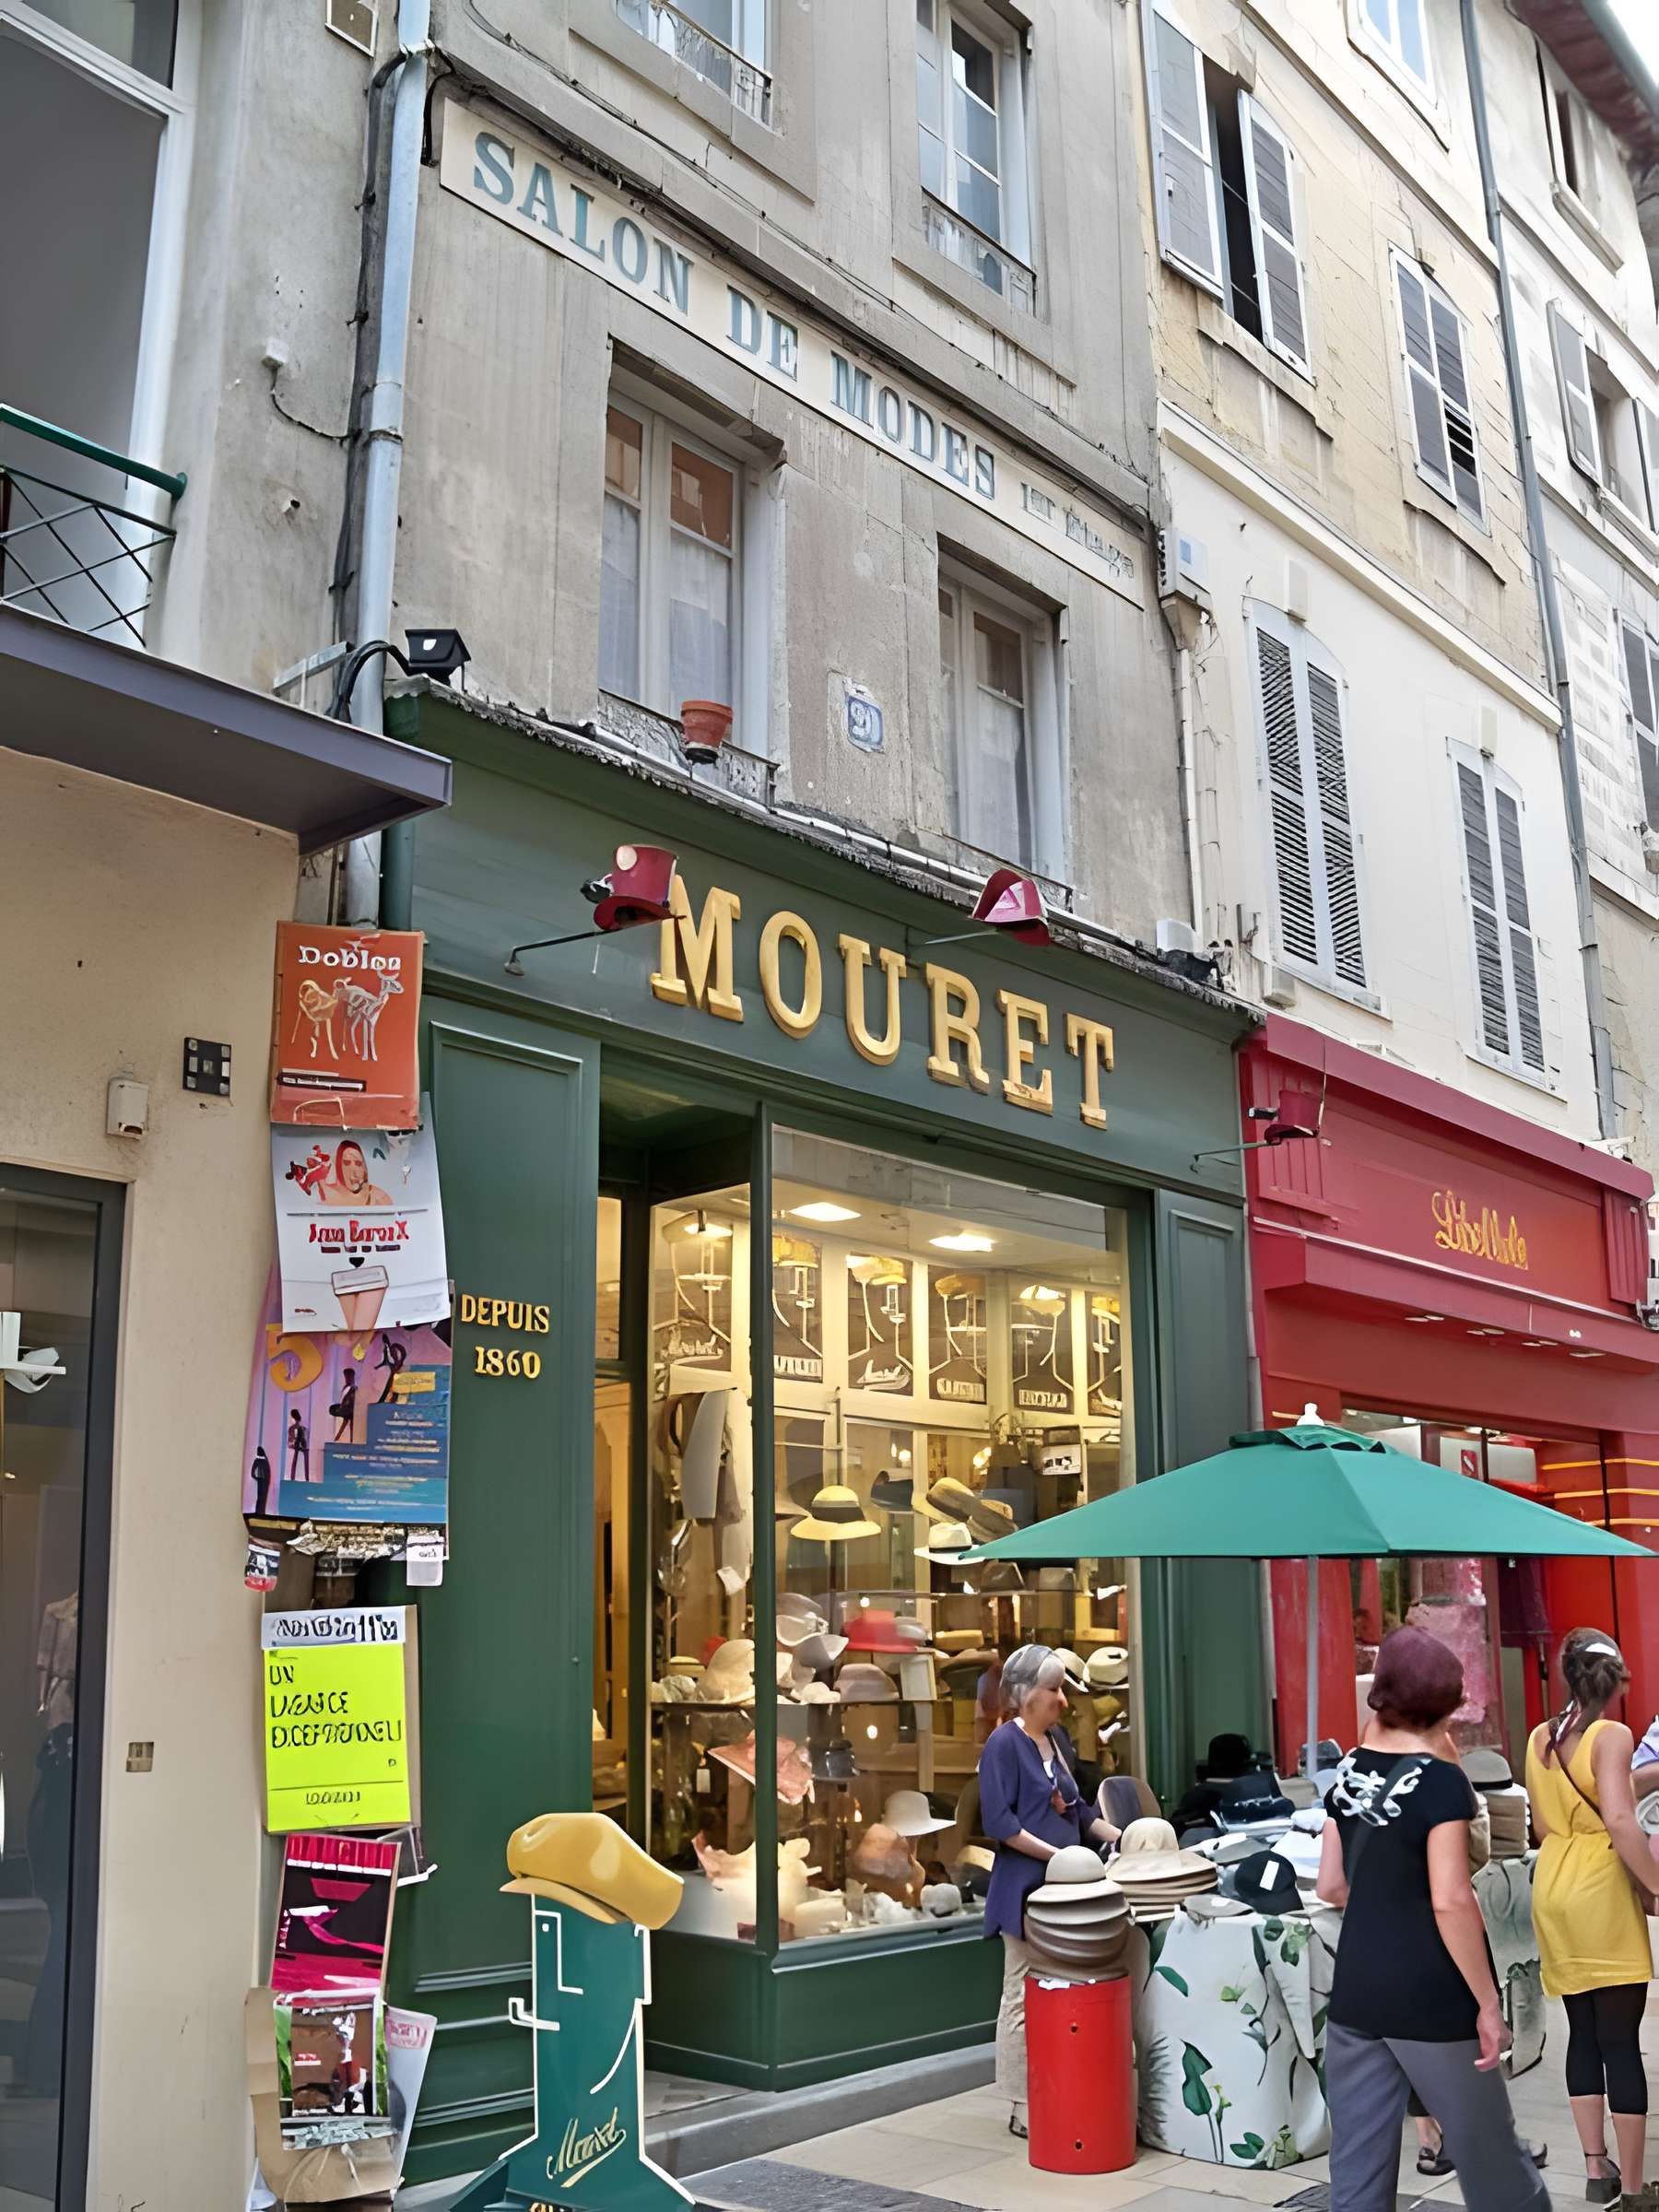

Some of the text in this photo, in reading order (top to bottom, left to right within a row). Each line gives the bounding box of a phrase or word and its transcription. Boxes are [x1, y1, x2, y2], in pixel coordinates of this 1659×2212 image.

[473, 131, 994, 500] SALON DE MODES
[650, 874, 1114, 1131] MOURET
[461, 1293, 550, 1334] DEPUIS
[475, 1345, 542, 1380] 1860
